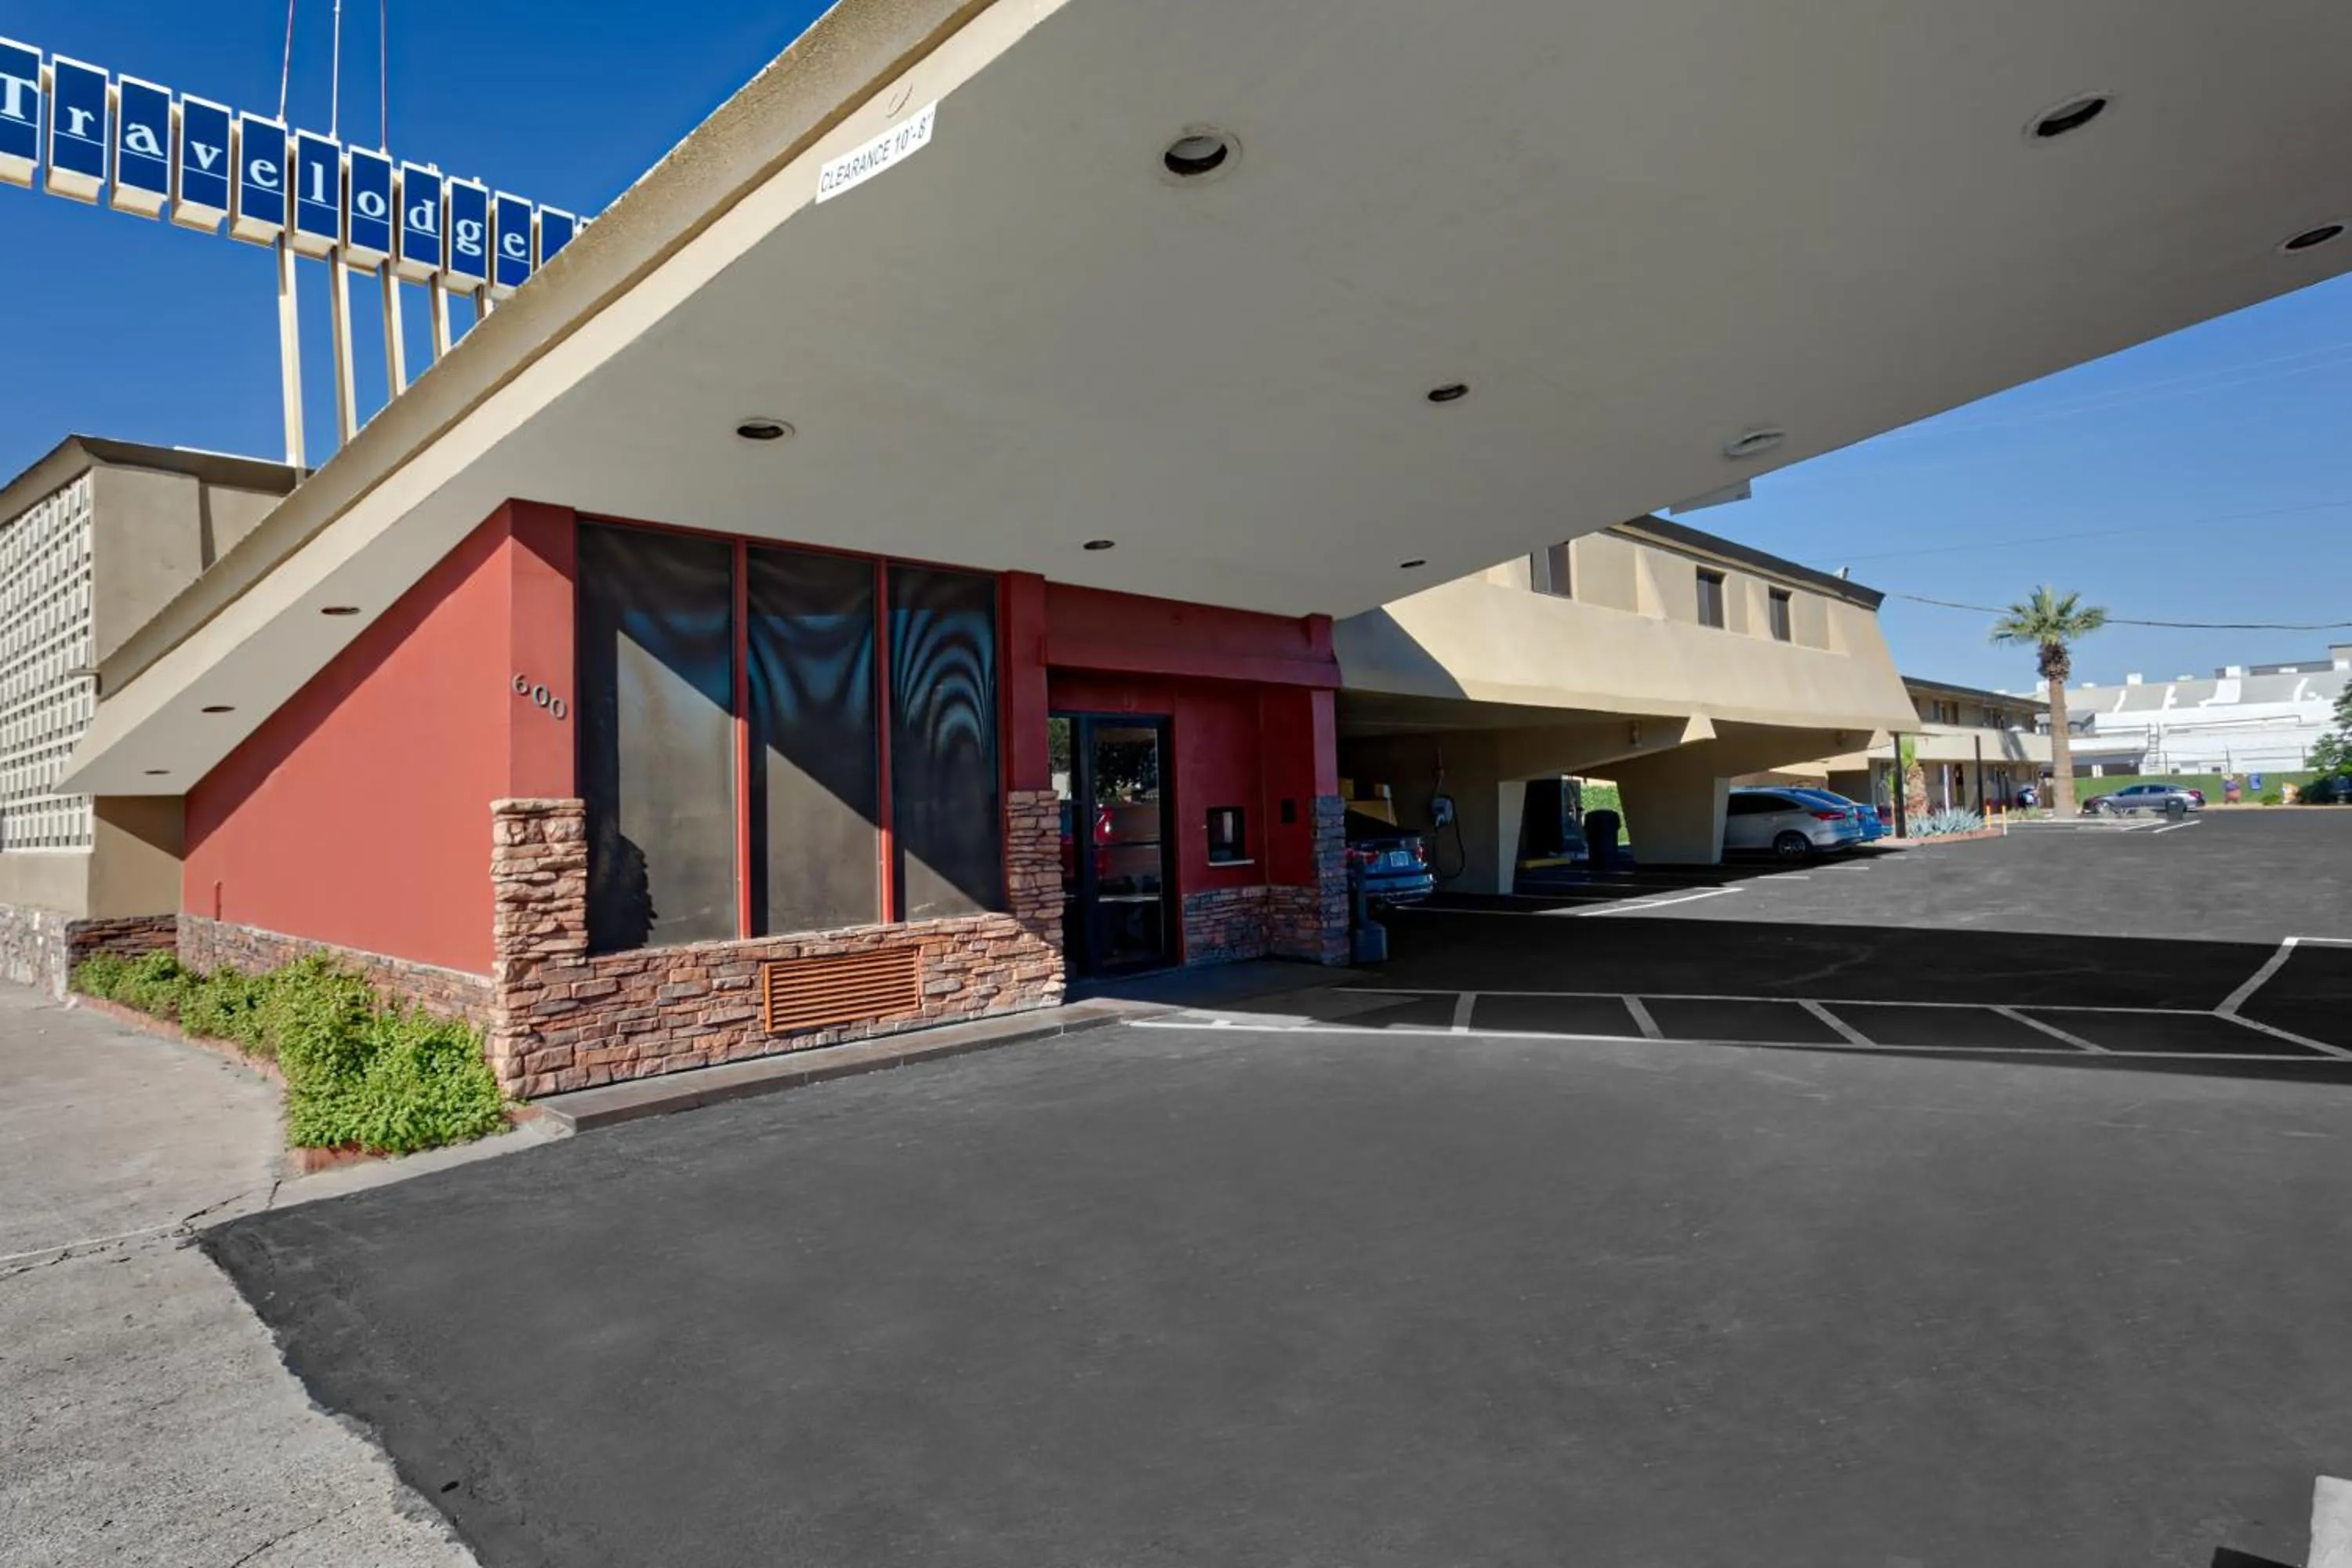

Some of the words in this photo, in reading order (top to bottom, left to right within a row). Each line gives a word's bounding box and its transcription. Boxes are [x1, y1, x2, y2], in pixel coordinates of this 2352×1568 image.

[0, 72, 526, 257] Travelodge
[821, 139, 891, 193] CLEARANCE
[512, 673, 568, 720] 600
